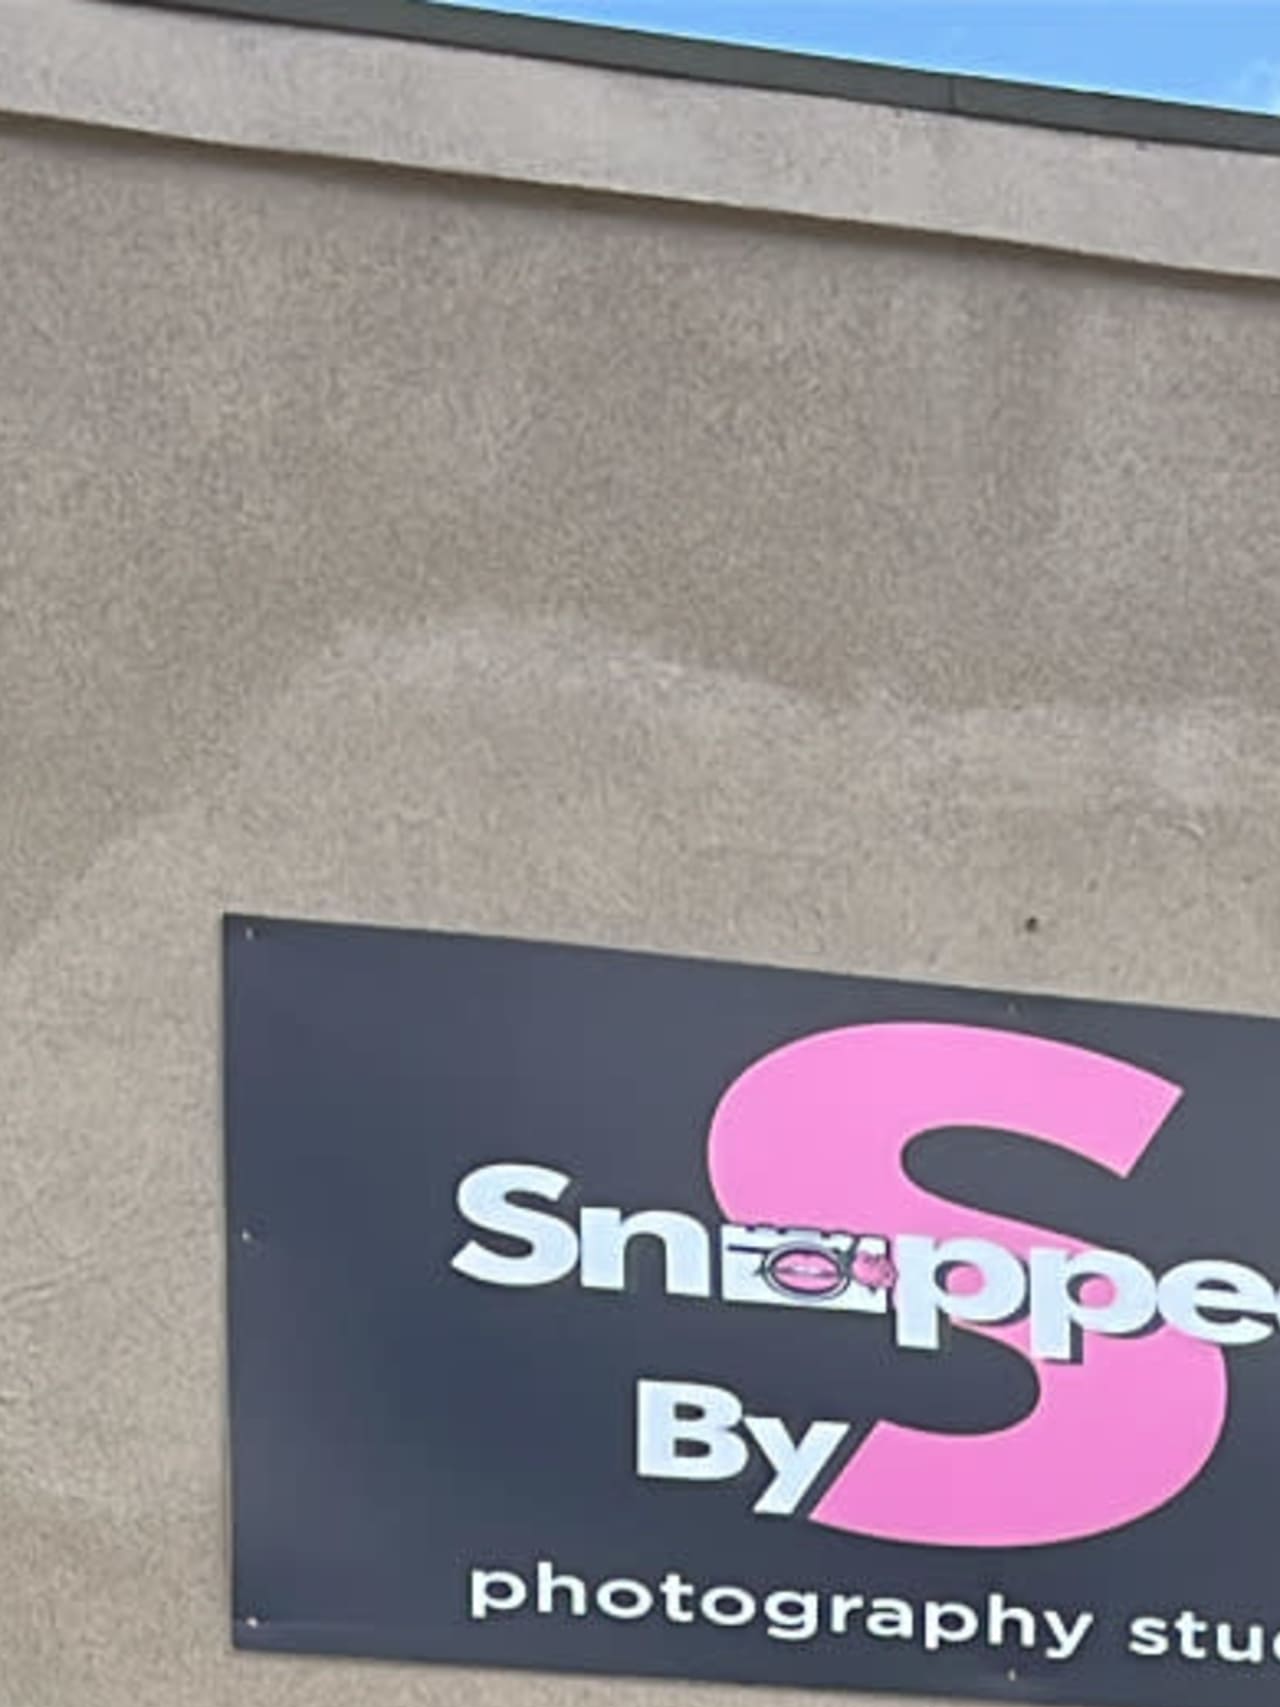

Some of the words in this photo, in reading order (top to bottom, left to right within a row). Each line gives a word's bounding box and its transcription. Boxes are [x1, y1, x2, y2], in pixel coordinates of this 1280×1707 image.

[706, 1022, 1230, 1549] S
[636, 1378, 851, 1516] By
[469, 1560, 1094, 1660] photography
